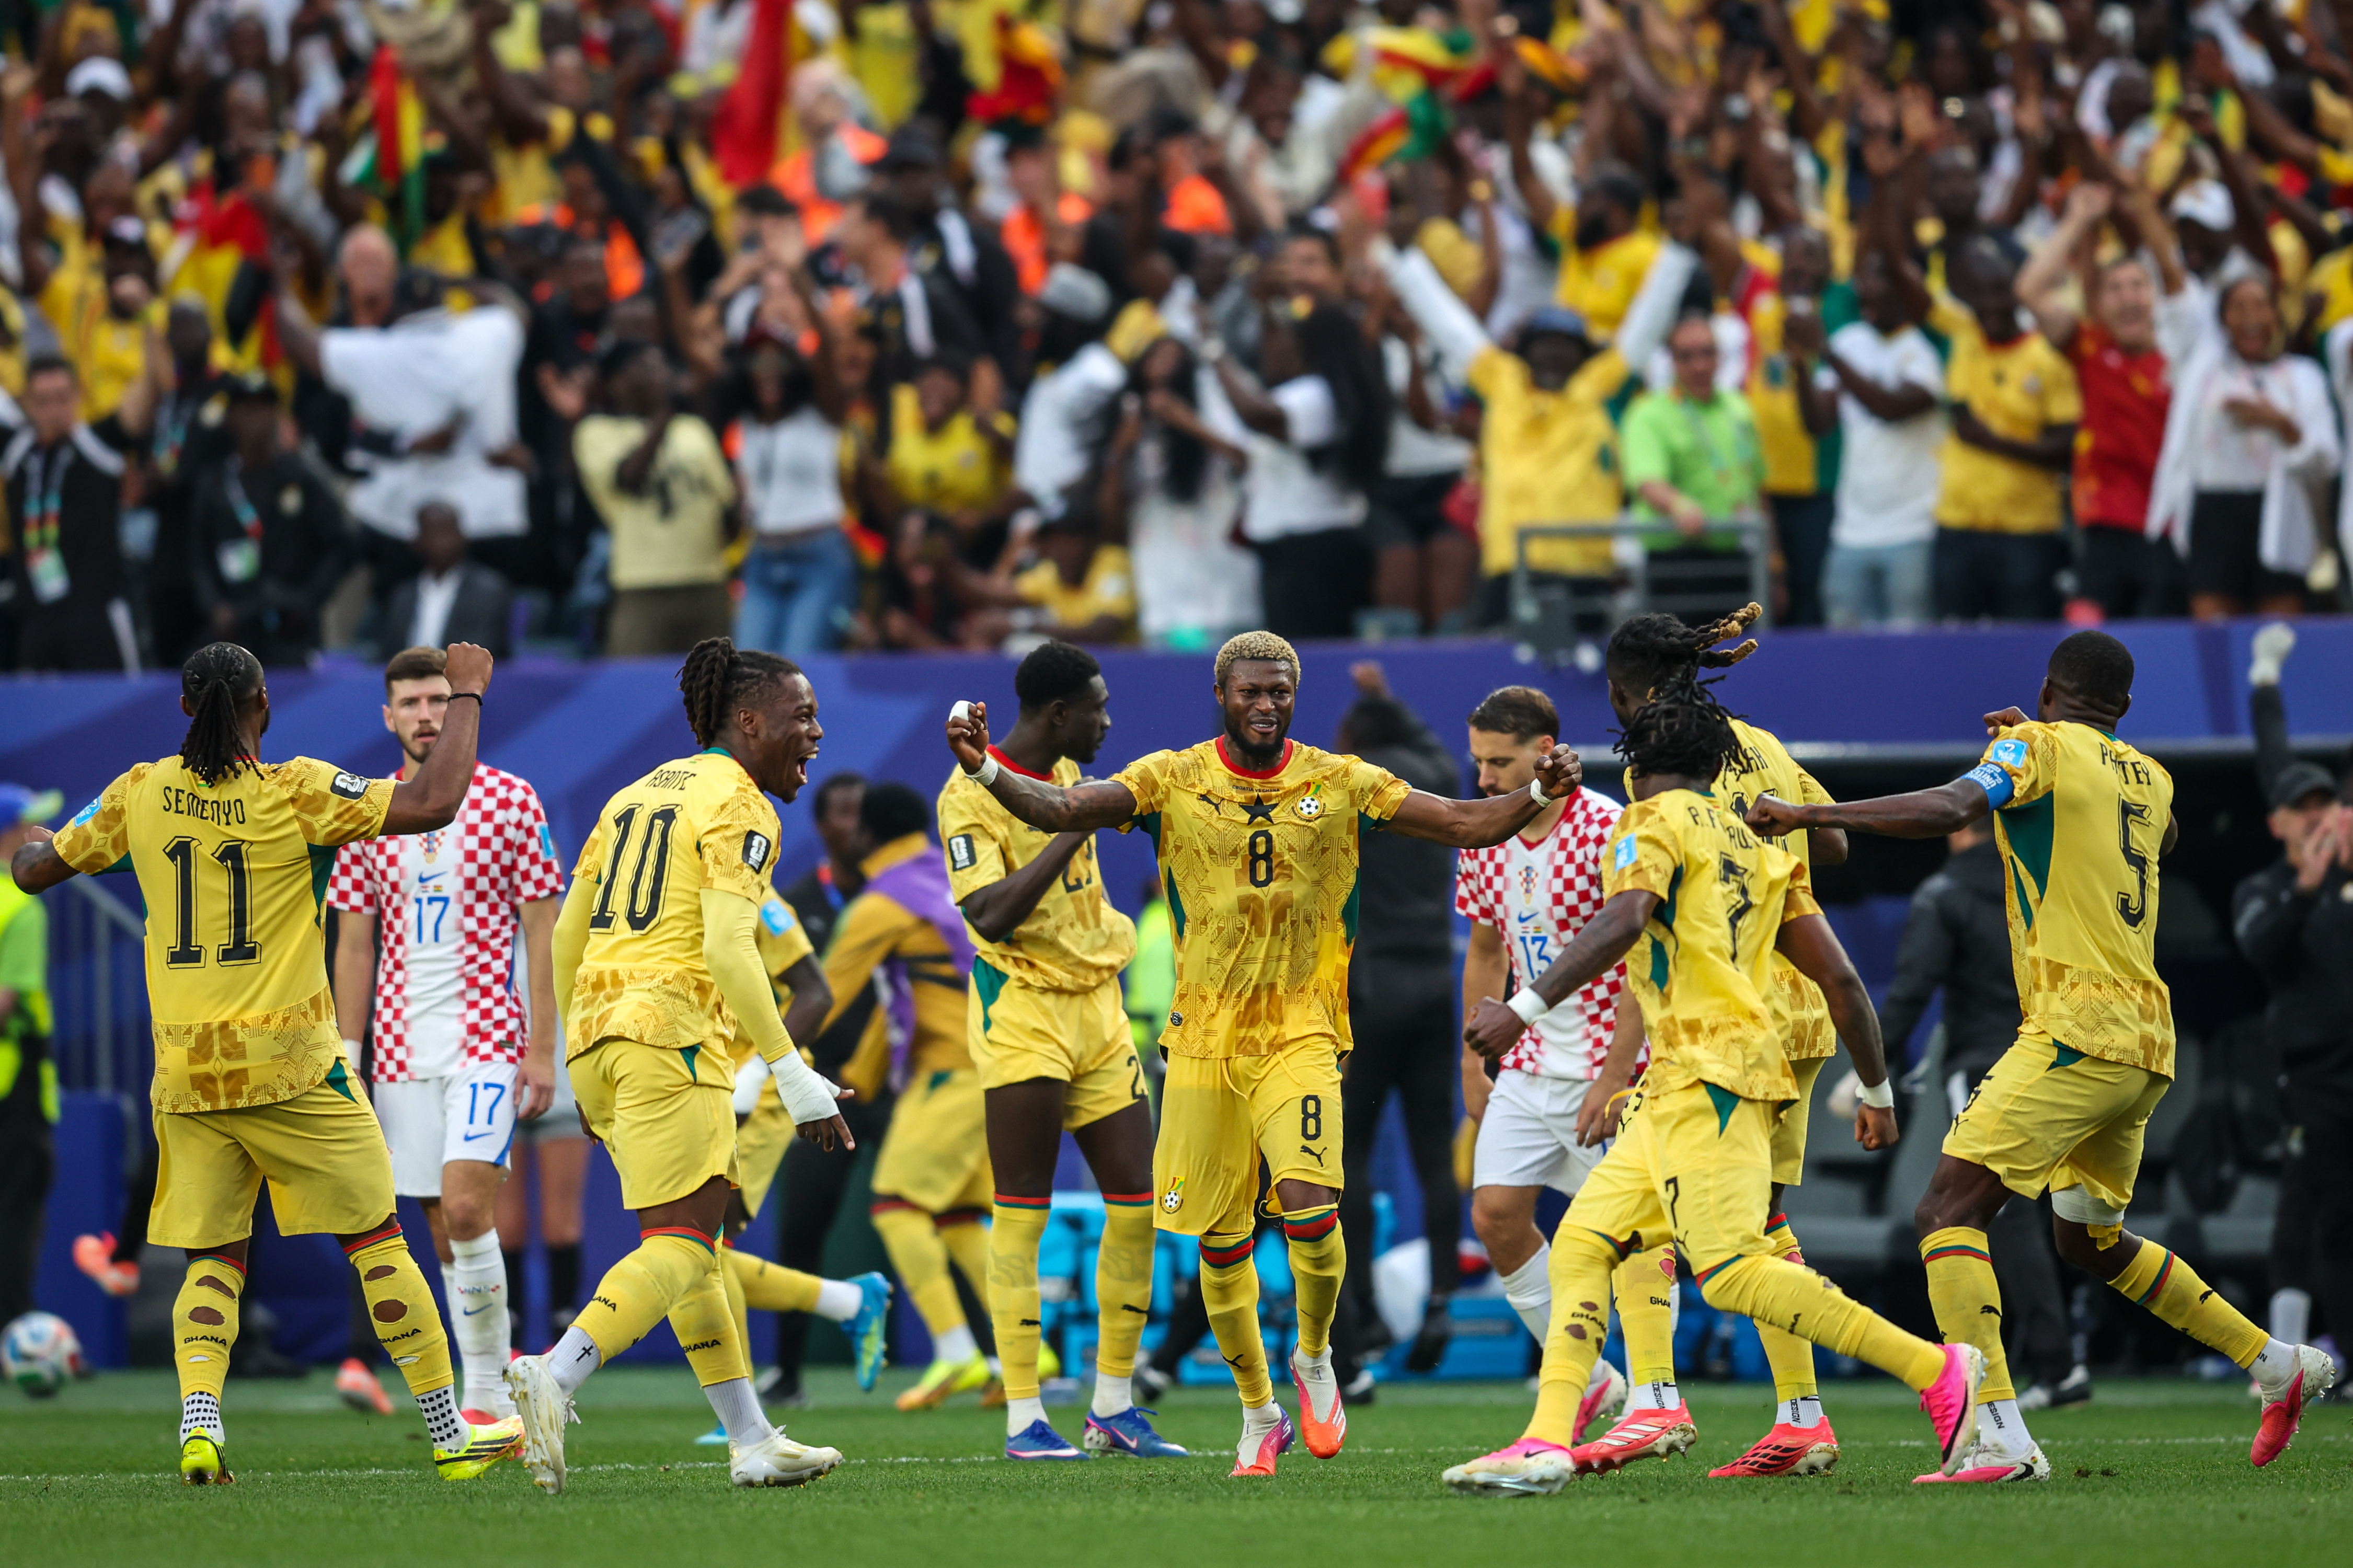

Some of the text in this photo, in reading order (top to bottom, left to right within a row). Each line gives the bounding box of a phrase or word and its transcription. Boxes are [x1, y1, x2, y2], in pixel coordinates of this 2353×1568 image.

[645, 769, 697, 790] ASANTE
[163, 786, 246, 826] SEMENYO
[590, 803, 682, 935] 10
[1249, 830, 1273, 888] 8
[2116, 793, 2152, 934] 5
[163, 836, 261, 970] 11
[415, 896, 450, 943] 17
[1519, 936, 1552, 981] 13
[469, 1082, 506, 1125] 17
[1301, 1094, 1322, 1141] 8
[1665, 1175, 1679, 1229] 7
[184, 1335, 227, 1346] GHANA
